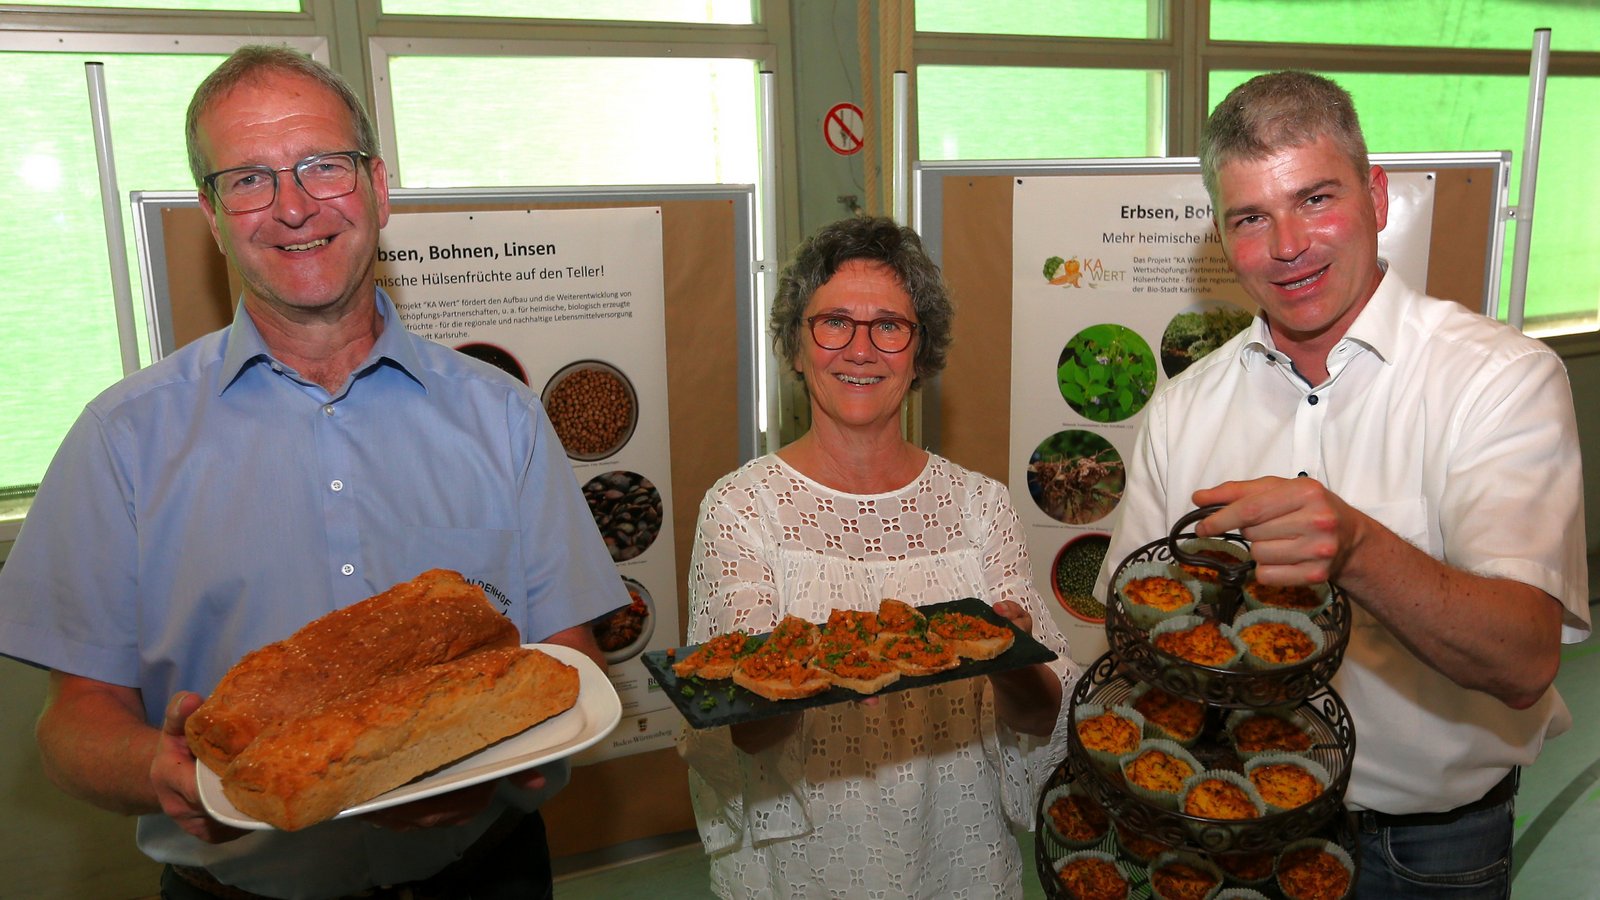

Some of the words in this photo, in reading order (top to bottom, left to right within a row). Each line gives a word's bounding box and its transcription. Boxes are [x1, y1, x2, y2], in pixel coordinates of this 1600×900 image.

[1121, 205, 1178, 221] Erbsen,
[1185, 204, 1214, 219] Boh
[1102, 232, 1134, 244] Mehr
[1139, 232, 1200, 244] heimische
[378, 247, 424, 264] bsen,
[429, 244, 498, 260] Bohnen,
[504, 242, 556, 256] Linsen
[1148, 256, 1171, 265] Projekt
[1084, 258, 1103, 272] KA
[374, 274, 418, 288] mische
[422, 270, 512, 286] Hülsenfrüchte
[516, 268, 536, 280] auf
[540, 268, 562, 280] den
[566, 265, 604, 278] Teller!
[1090, 270, 1126, 282] WERT
[396, 302, 422, 310] Projekt
[462, 298, 486, 306] fördert
[503, 296, 528, 304] Aufbau
[557, 292, 618, 302] Weiterentwicklung
[400, 308, 500, 320] schöpfungs-Partnerschaften,
[530, 304, 566, 313] heimische,
[568, 302, 600, 312] biologisch
[404, 322, 433, 330] früchte
[464, 319, 496, 328] regionale
[514, 315, 552, 324] nachhaltige
[554, 310, 632, 322] Lebensmittelversorgung
[434, 332, 470, 340] Karlsruhe.
[464, 578, 512, 606] ALDENHOF
